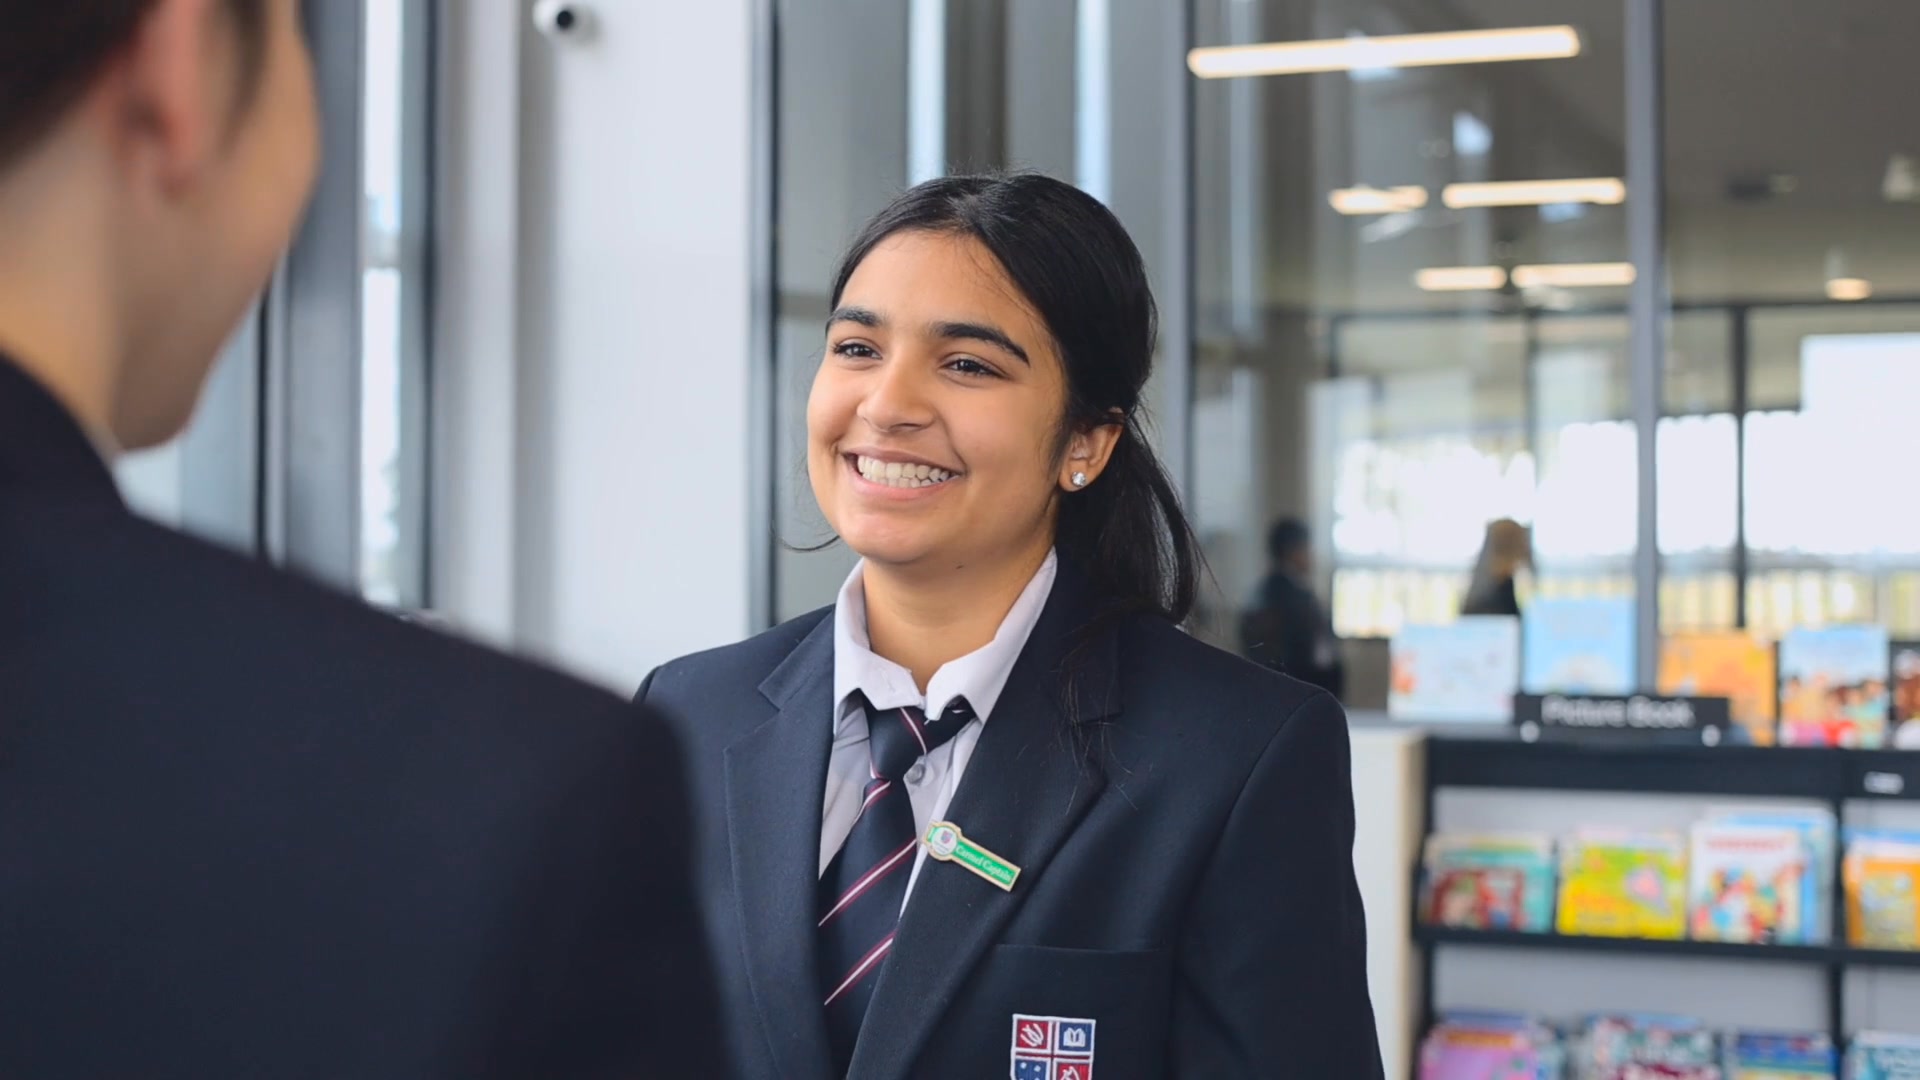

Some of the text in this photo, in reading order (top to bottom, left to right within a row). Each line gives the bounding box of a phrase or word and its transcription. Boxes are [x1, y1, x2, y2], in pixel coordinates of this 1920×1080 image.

[1541, 695, 1695, 728] Picture Book
[982, 861, 1012, 882] Captain
